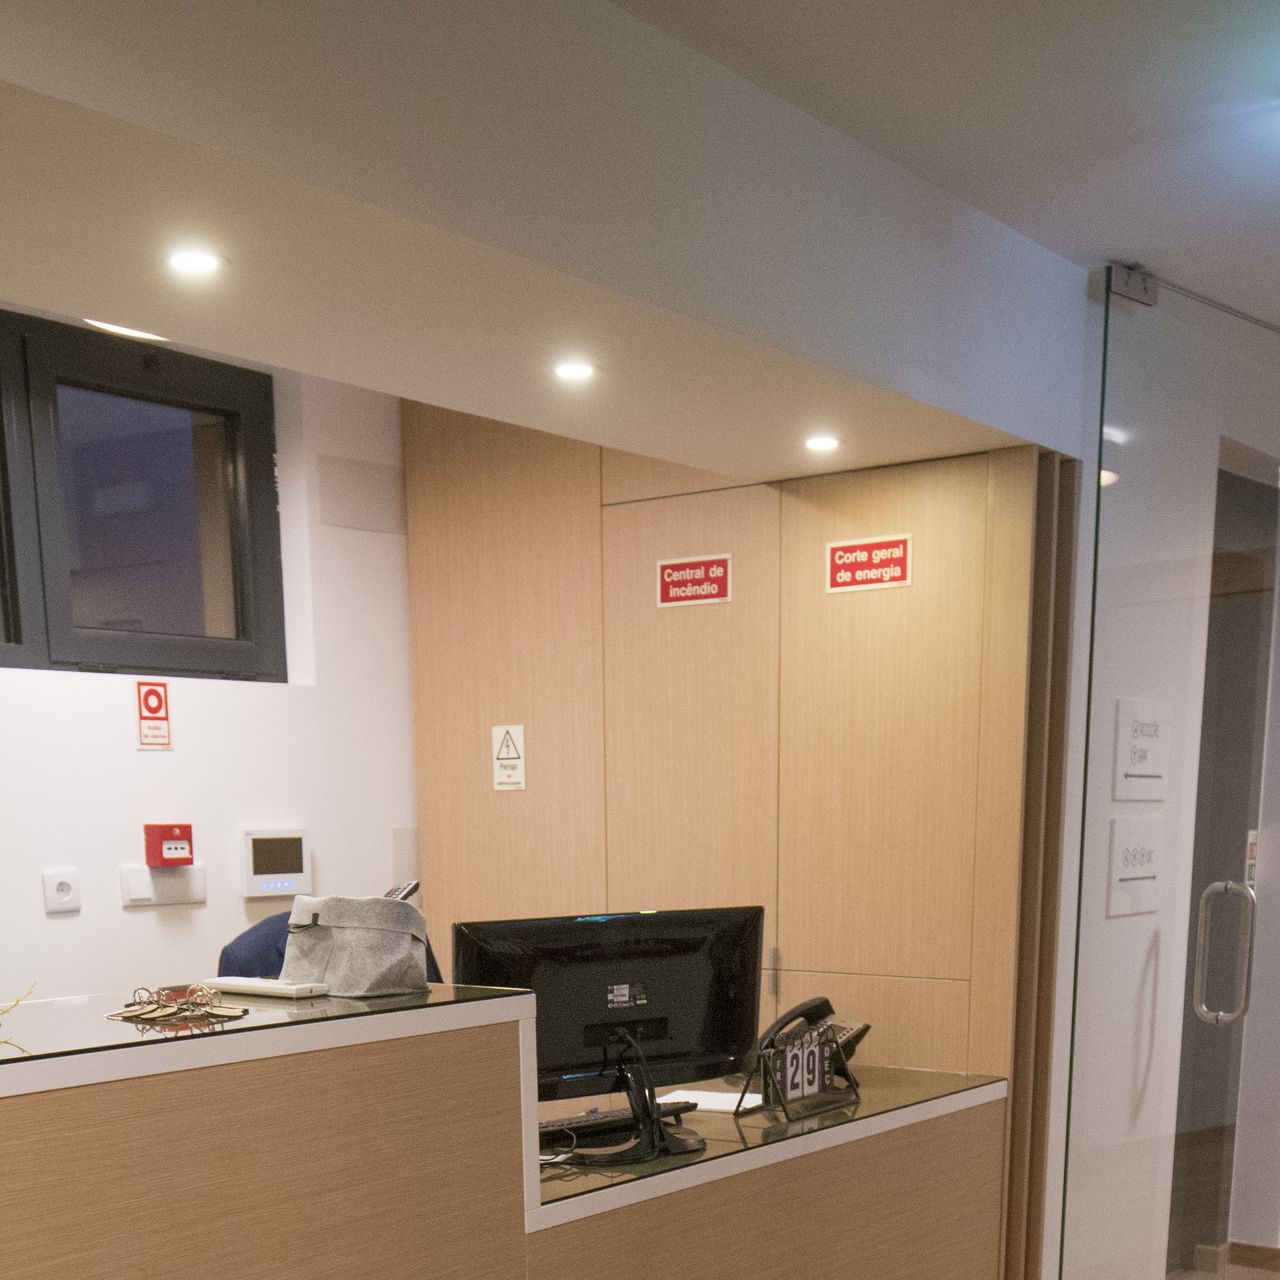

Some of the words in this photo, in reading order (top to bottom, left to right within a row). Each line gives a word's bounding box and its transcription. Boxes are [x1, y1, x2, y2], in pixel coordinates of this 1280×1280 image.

[834, 549, 868, 565] Corte
[872, 544, 904, 564] geral
[663, 565, 705, 582] Central
[708, 564, 724, 578] de
[836, 569, 852, 583] de
[855, 564, 901, 581] energia
[669, 581, 719, 598] incêndio
[790, 1050, 816, 1091] 29
